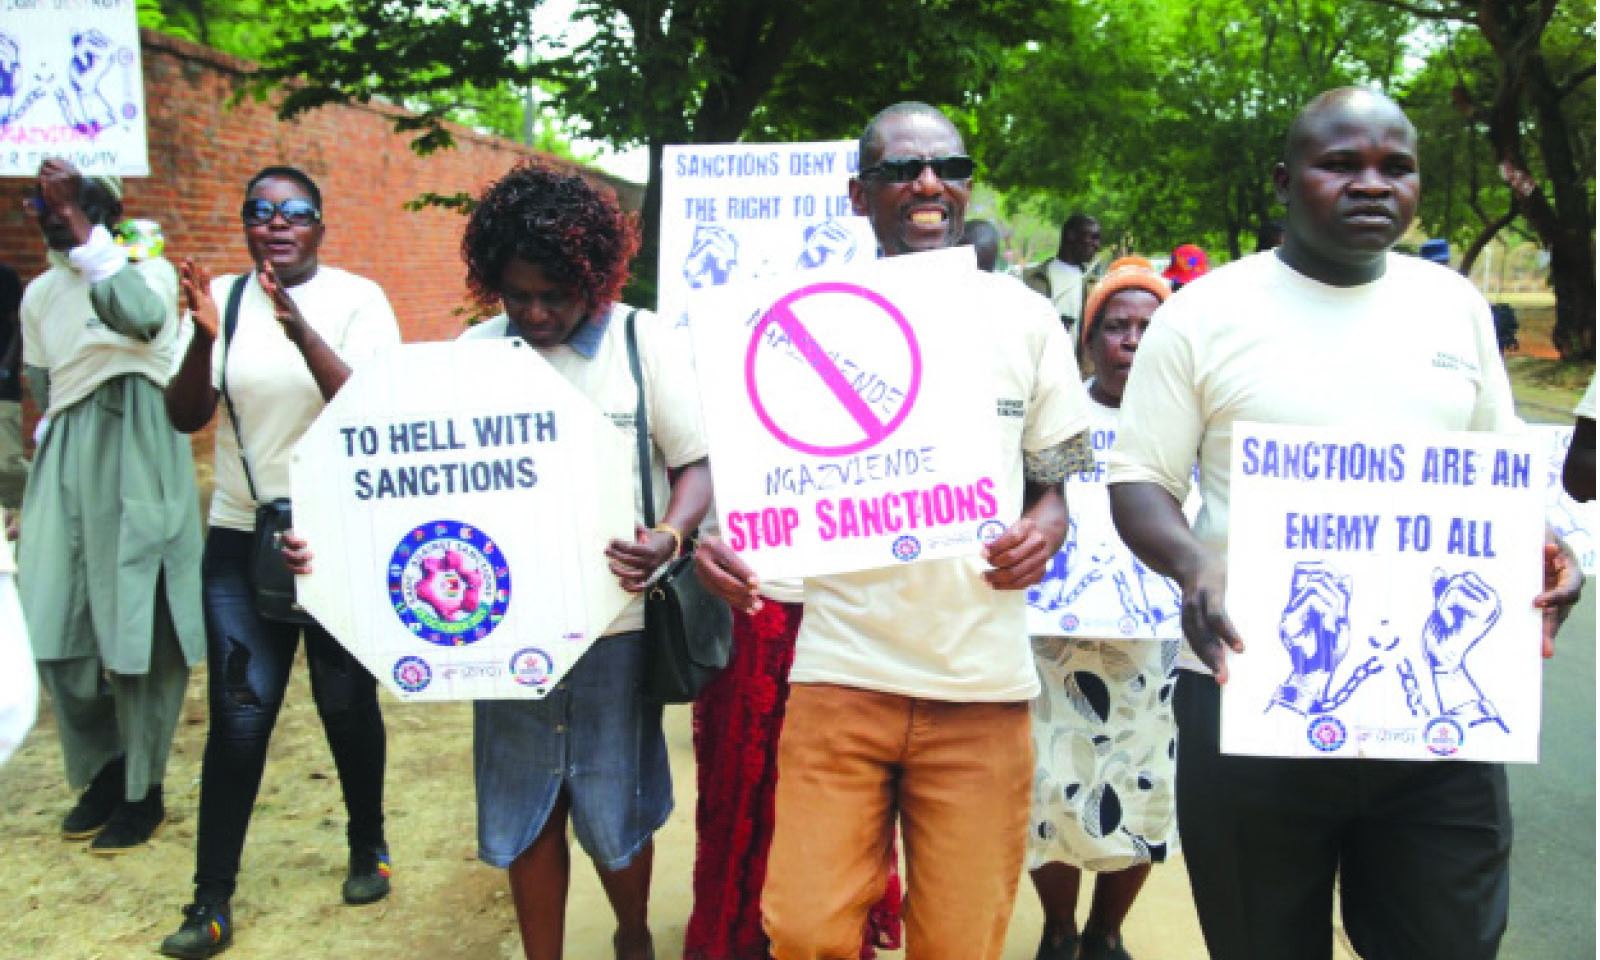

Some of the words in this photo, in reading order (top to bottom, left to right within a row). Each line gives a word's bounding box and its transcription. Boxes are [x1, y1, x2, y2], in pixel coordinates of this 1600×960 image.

[677, 152, 779, 177] SANCTIONS
[790, 151, 836, 175] DENY
[846, 151, 860, 174] U
[684, 197, 717, 221] THE
[728, 197, 781, 220] RIGHT
[794, 194, 816, 217] TO
[826, 195, 850, 217] LIF
[340, 426, 378, 457] TO
[388, 419, 466, 454] HELL
[473, 411, 557, 448] WITH
[355, 457, 538, 501] SANCTIONS
[766, 446, 937, 496] NGAZVIENDE
[1242, 437, 1405, 483] SANCTIONS
[1421, 447, 1477, 486] ARE
[1491, 449, 1530, 488] AN
[728, 507, 799, 551] STOP
[815, 477, 998, 541] SANCTIONS
[1285, 513, 1380, 551] ENEMY
[1395, 514, 1431, 552] TO
[1447, 517, 1496, 558] ALL
